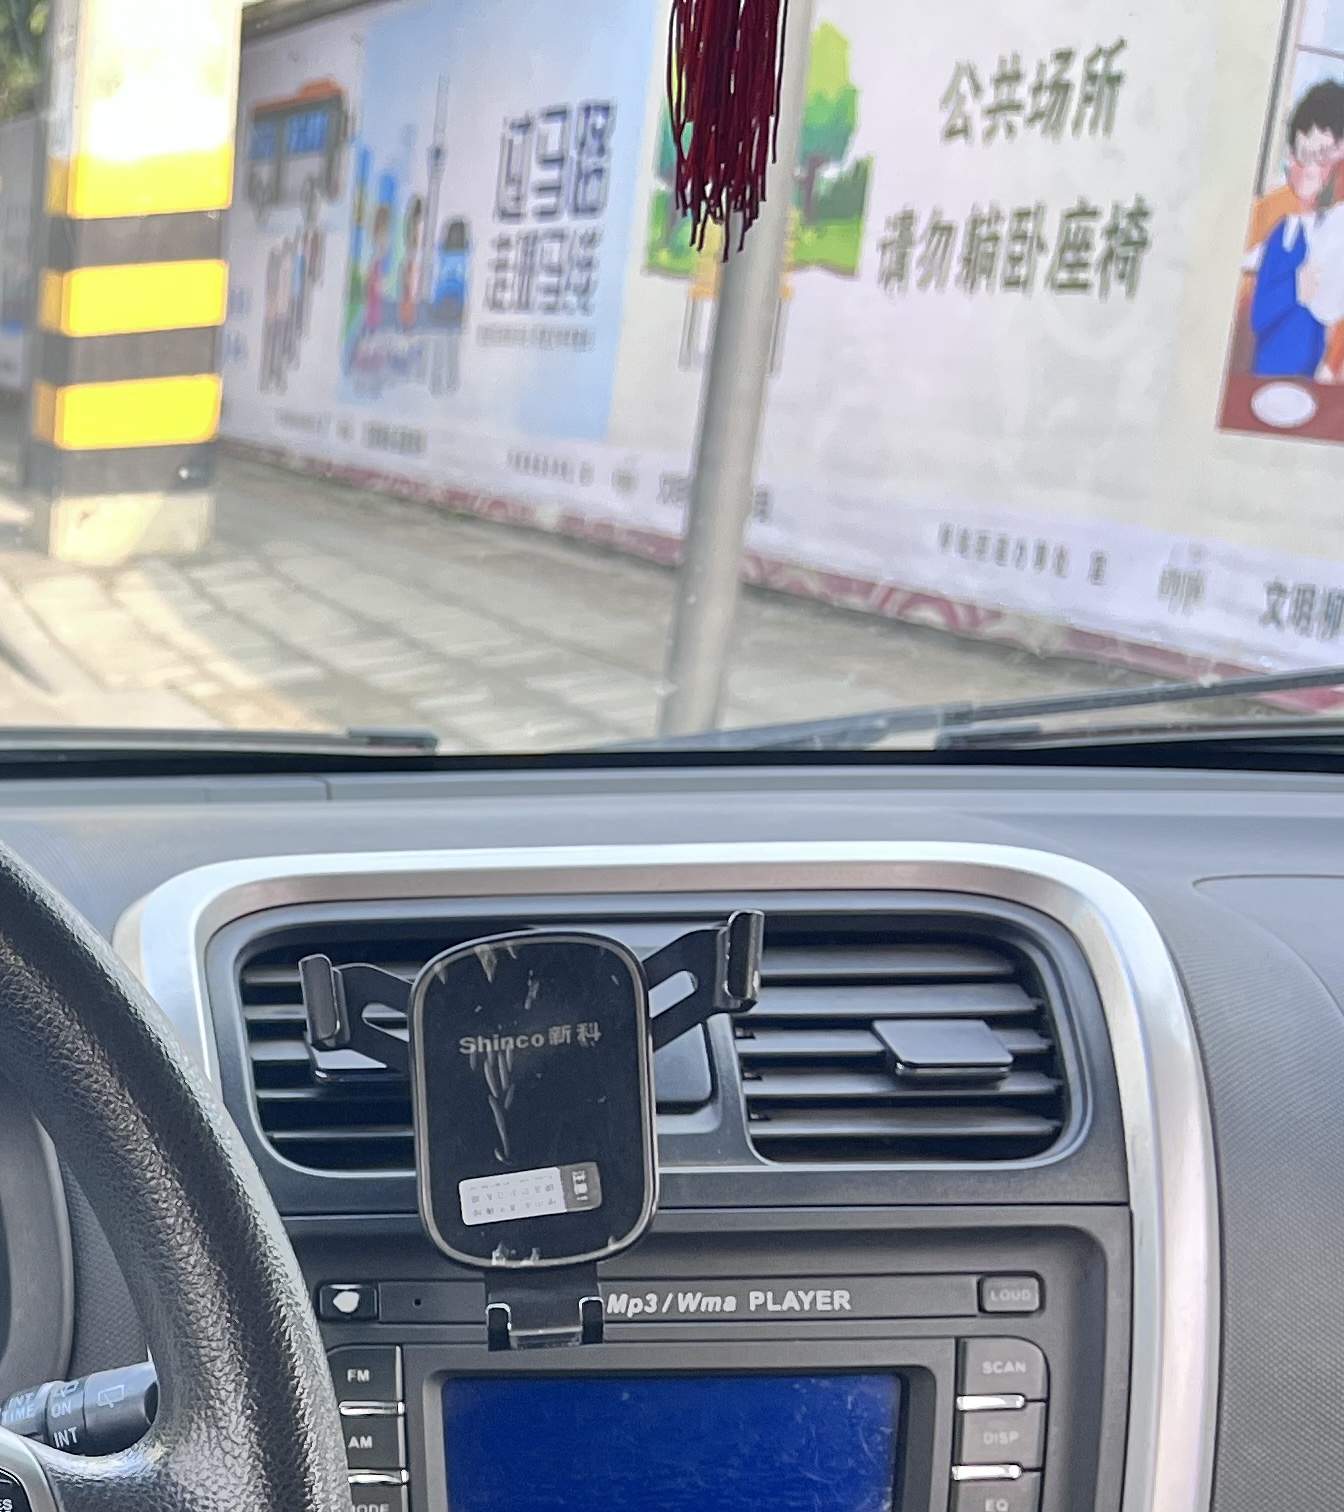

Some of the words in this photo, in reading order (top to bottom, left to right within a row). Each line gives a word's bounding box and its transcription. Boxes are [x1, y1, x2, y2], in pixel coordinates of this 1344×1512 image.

[940, 38, 1126, 143] 公共场所
[495, 100, 616, 223] 过马路
[878, 195, 1151, 300] 请勿躺卧座椅
[459, 1033, 545, 1054] Shinco
[749, 1290, 852, 1312] PLAYER
[990, 1288, 1032, 1302] LOUD
[347, 1369, 371, 1382] FM
[982, 1360, 1027, 1375] SCAN
[51, 1400, 72, 1418] ON
[53, 1426, 78, 1448] INT
[348, 1436, 373, 1448] AM
[983, 1431, 1020, 1445] DISP
[984, 1499, 1009, 1512] EQ
